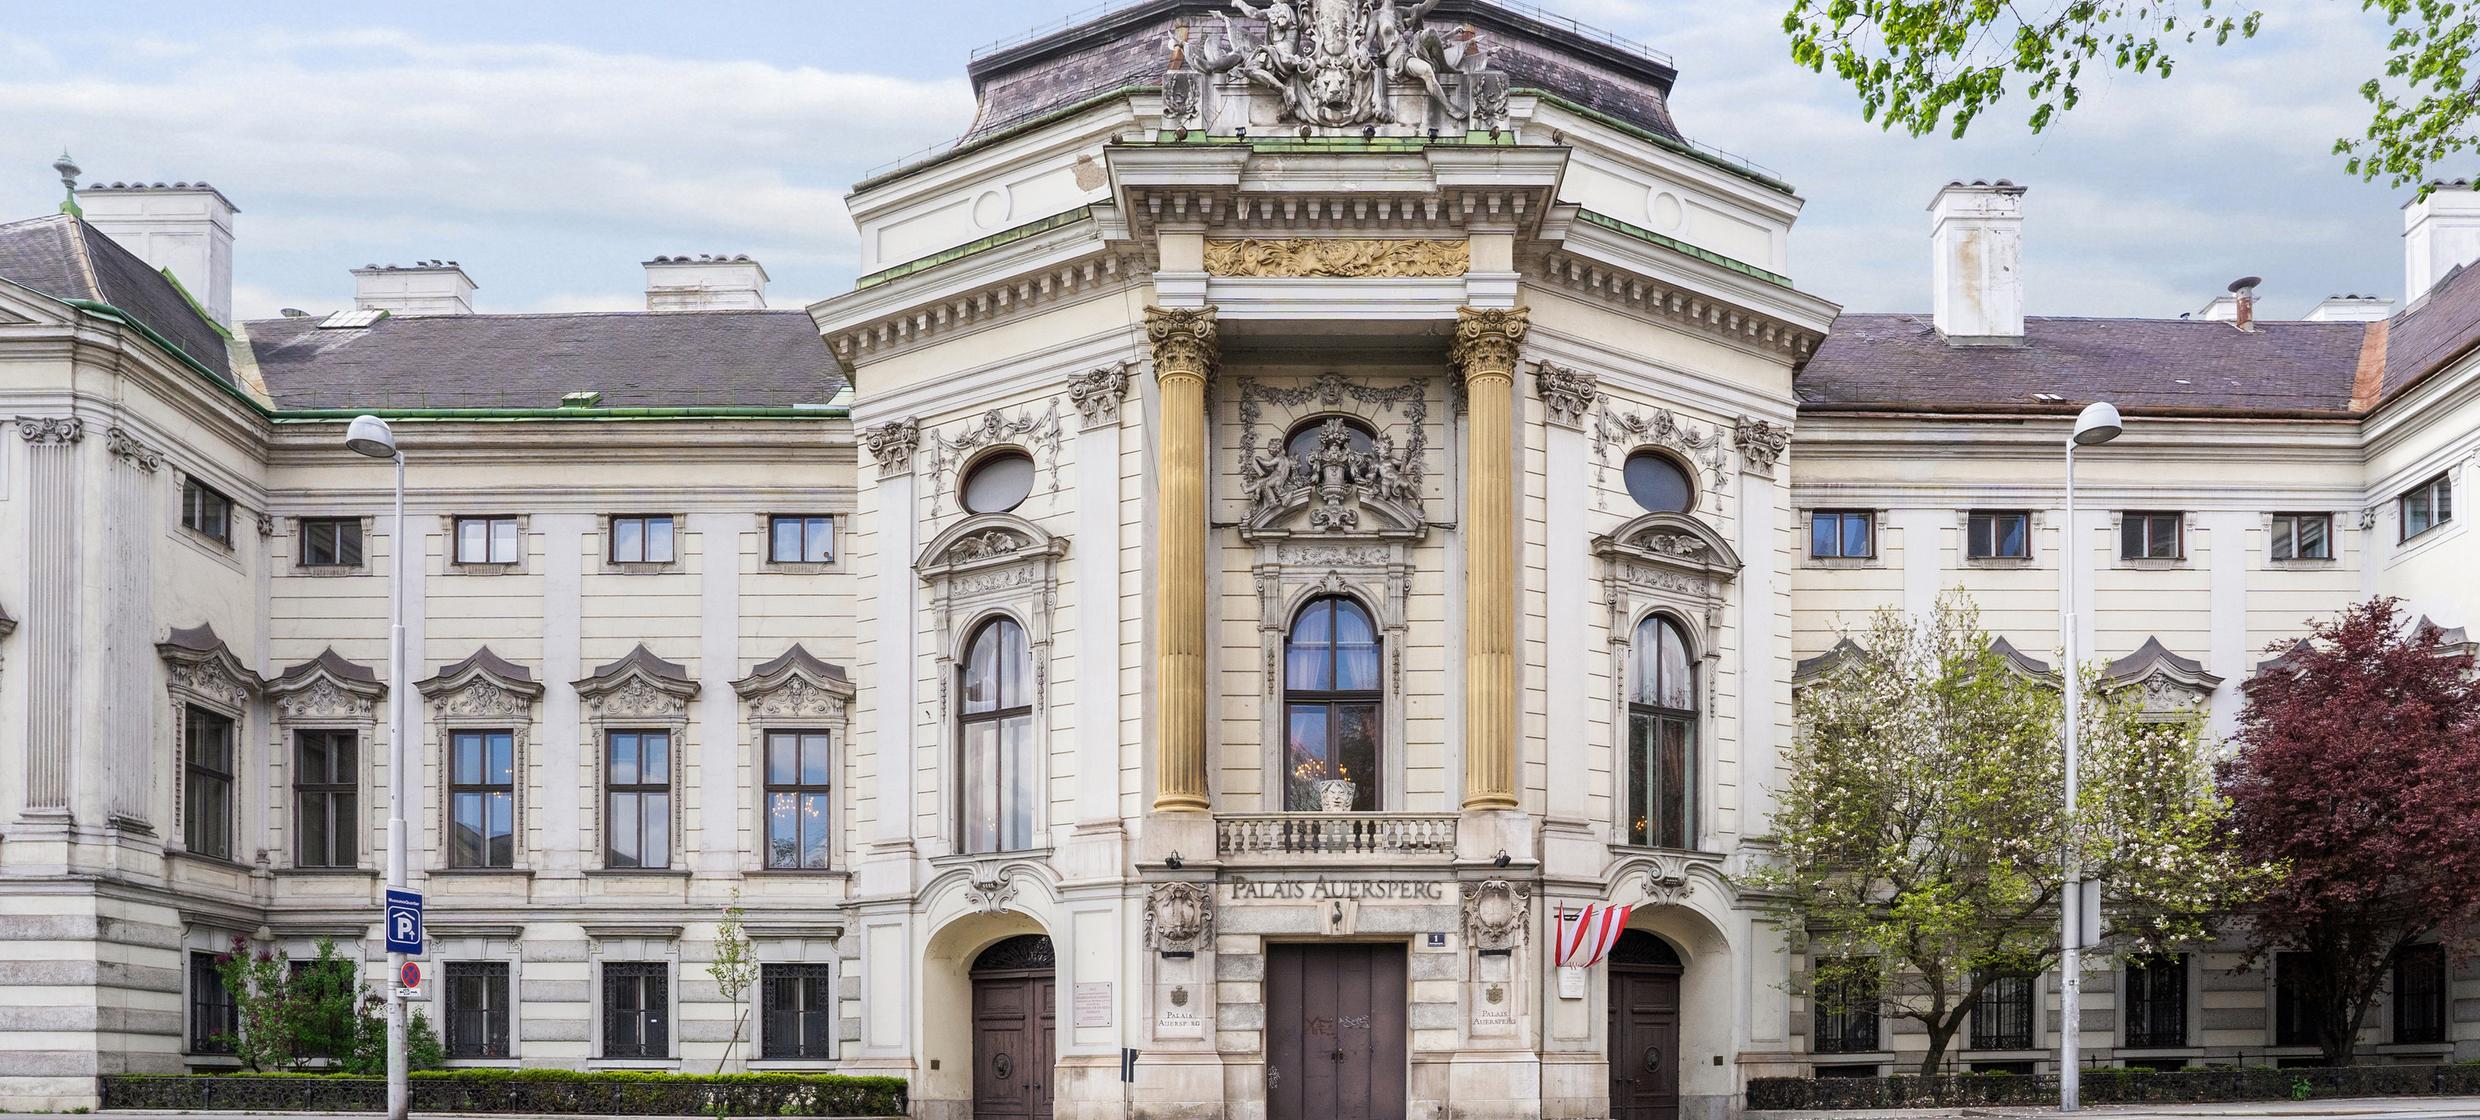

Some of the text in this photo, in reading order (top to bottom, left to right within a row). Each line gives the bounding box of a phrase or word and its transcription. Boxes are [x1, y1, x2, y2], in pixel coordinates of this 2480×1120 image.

[1231, 874, 1442, 900] PALAIS AUERSPERG
[398, 917, 412, 939] P
[1434, 934, 1438, 942] 1
